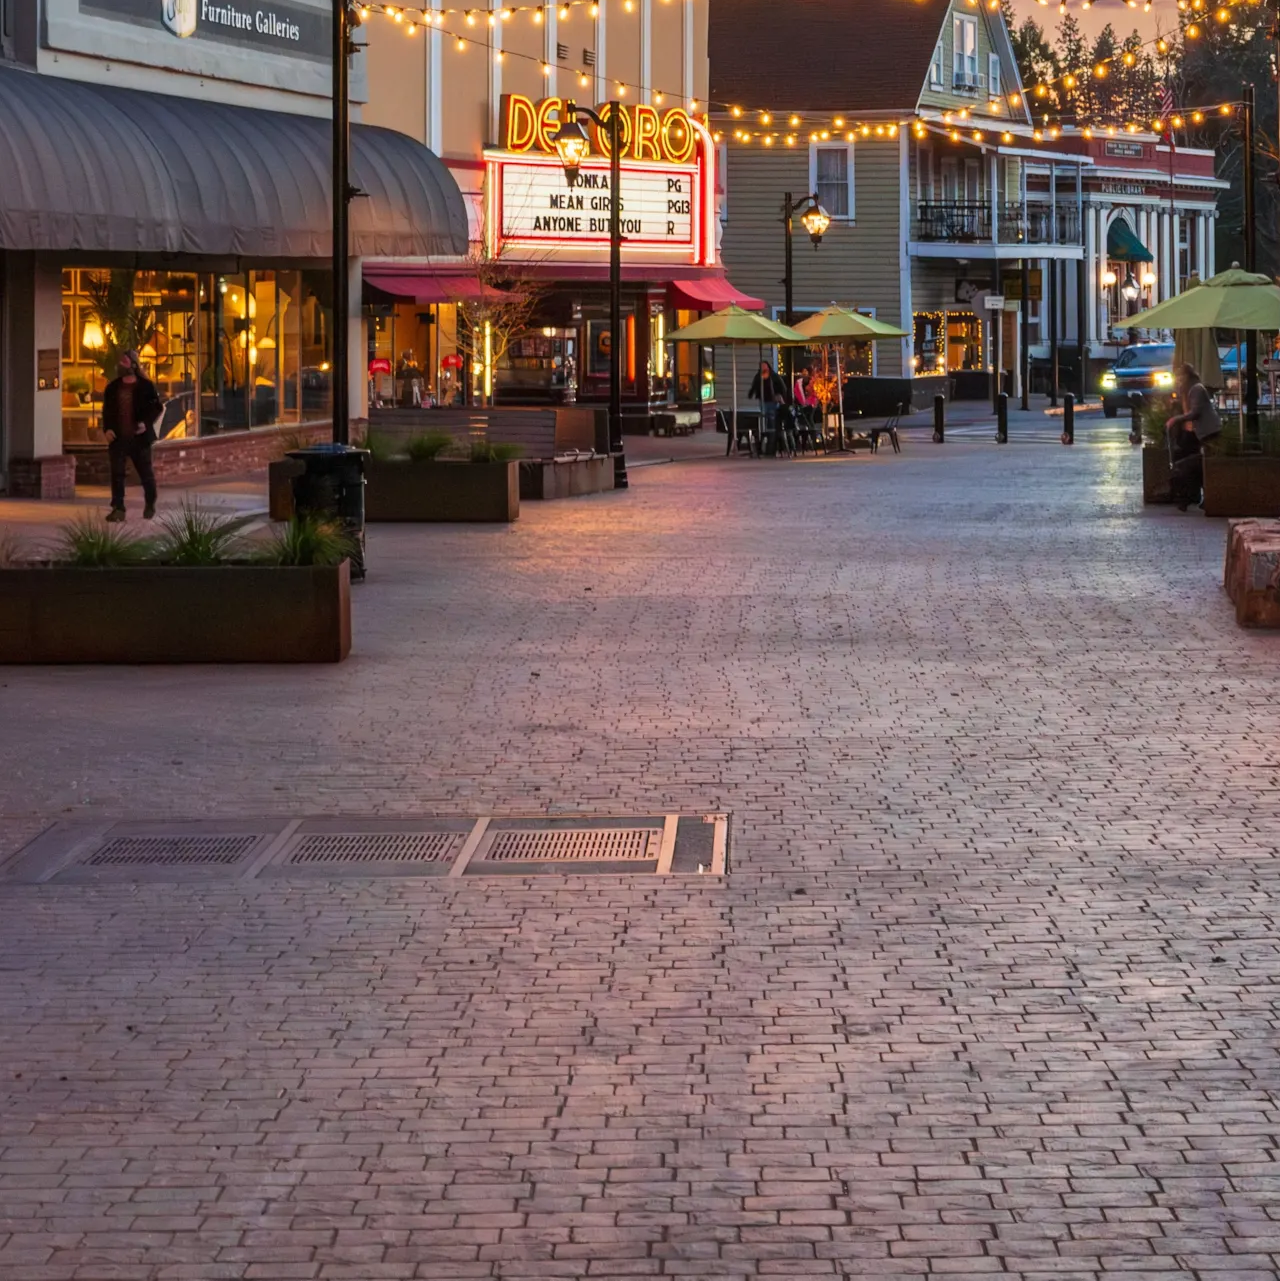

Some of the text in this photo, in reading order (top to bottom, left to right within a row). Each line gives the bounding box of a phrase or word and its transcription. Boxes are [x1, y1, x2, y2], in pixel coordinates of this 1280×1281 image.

[255, 10, 300, 41] Galleries
[596, 103, 695, 164] ORO
[575, 173, 609, 190] ONKA
[666, 178, 682, 193] PG
[549, 193, 624, 212] MEAN GIRS
[666, 199, 691, 215] PG13
[533, 214, 582, 232] ANYONE
[619, 218, 641, 234] YOU
[666, 220, 675, 235] R
